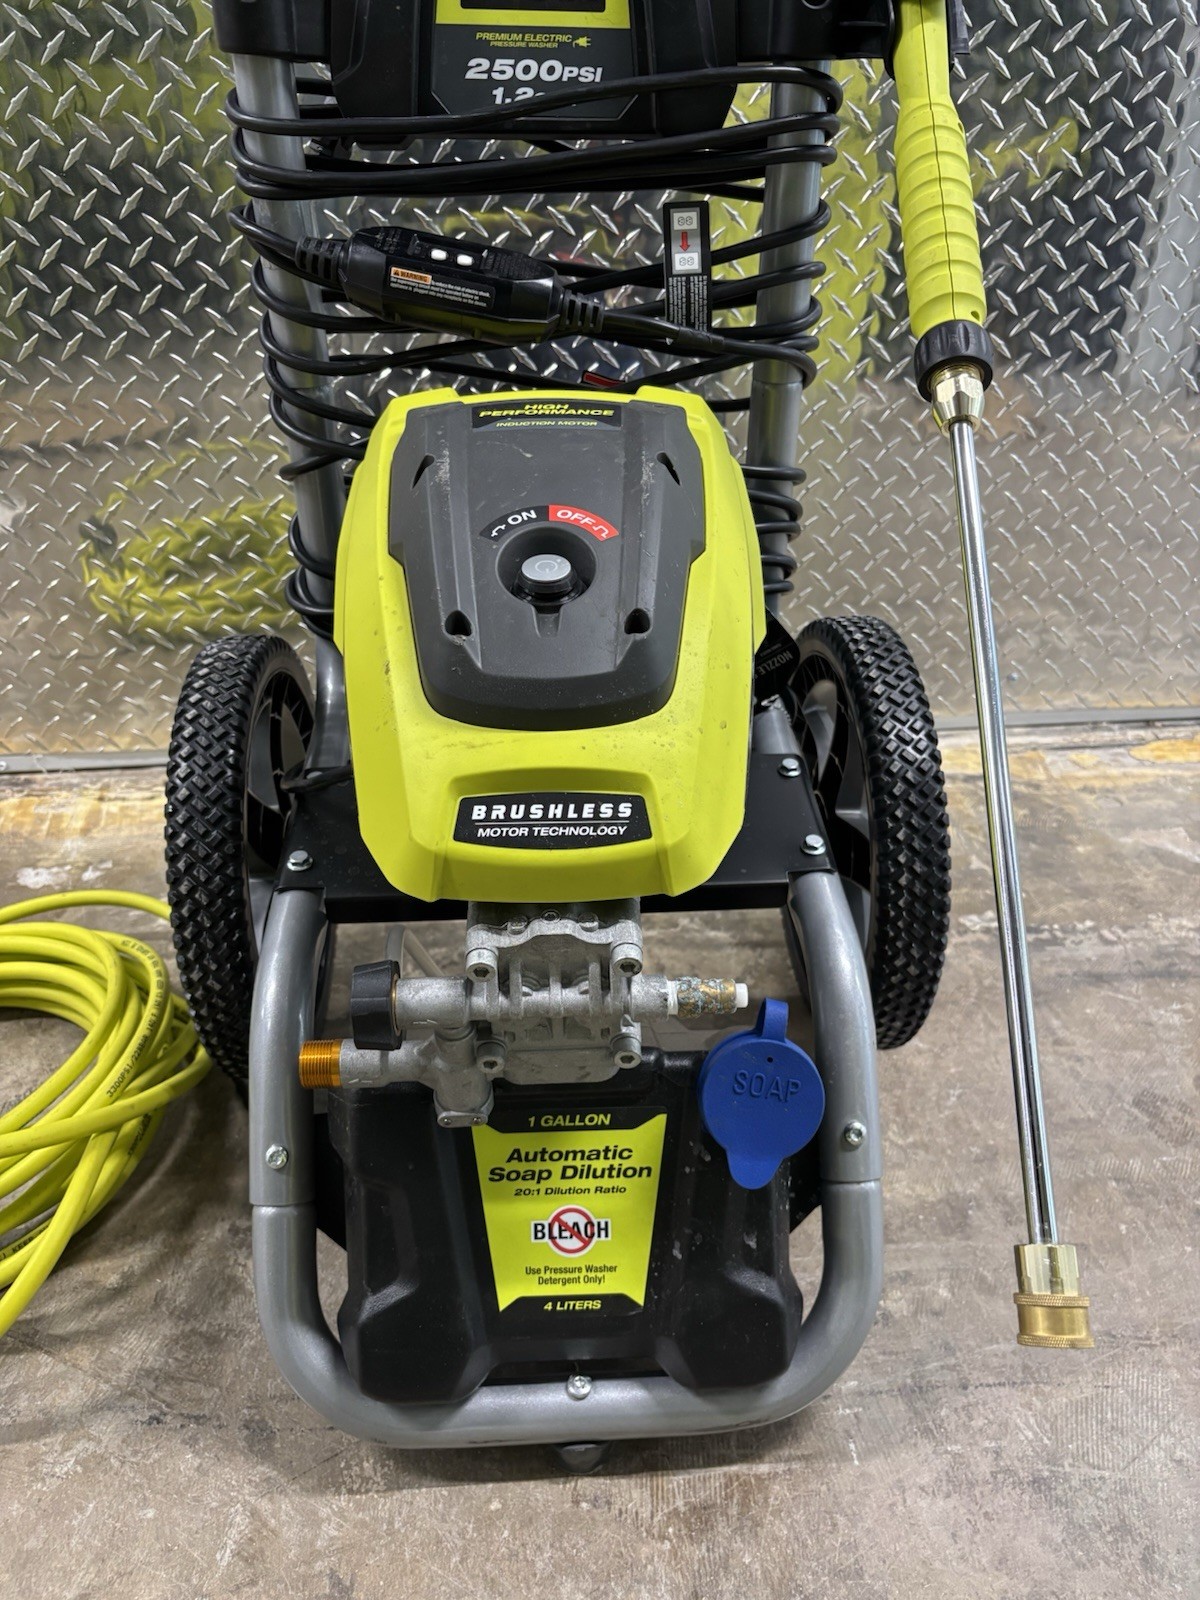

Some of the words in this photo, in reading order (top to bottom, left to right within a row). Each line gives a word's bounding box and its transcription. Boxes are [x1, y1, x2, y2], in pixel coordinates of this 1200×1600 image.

[476, 32, 523, 42] PREMIUM
[524, 33, 572, 43] ELECTRIC
[528, 41, 558, 49] WASHER
[400, 270, 429, 282] WARNING
[479, 409, 615, 418] PERFORMANCE
[507, 509, 538, 526] ON
[556, 509, 597, 526] OFF
[756, 650, 793, 675] NOZZLE
[471, 802, 633, 820] BRUSHLESS
[477, 827, 529, 838] MOTOR
[532, 825, 628, 836] TECHNOLOGY
[732, 1069, 801, 1103] SOAP
[528, 1117, 535, 1127] 1
[541, 1113, 611, 1127] GALLON
[506, 1145, 633, 1163] Automatic
[488, 1167, 552, 1184] Soap
[560, 1164, 652, 1180] Dilution
[514, 1188, 541, 1196] 20:1
[544, 1186, 591, 1196] Dilution
[594, 1185, 627, 1194] Ratio
[533, 1221, 609, 1240] BLEACH
[525, 1266, 541, 1275] Use
[544, 1265, 582, 1275] Pressure
[585, 1264, 617, 1273] Washer
[538, 1275, 581, 1286] Detergent
[583, 1274, 606, 1285] Only!
[543, 1302, 552, 1310] 4
[556, 1300, 602, 1311] LITERS
